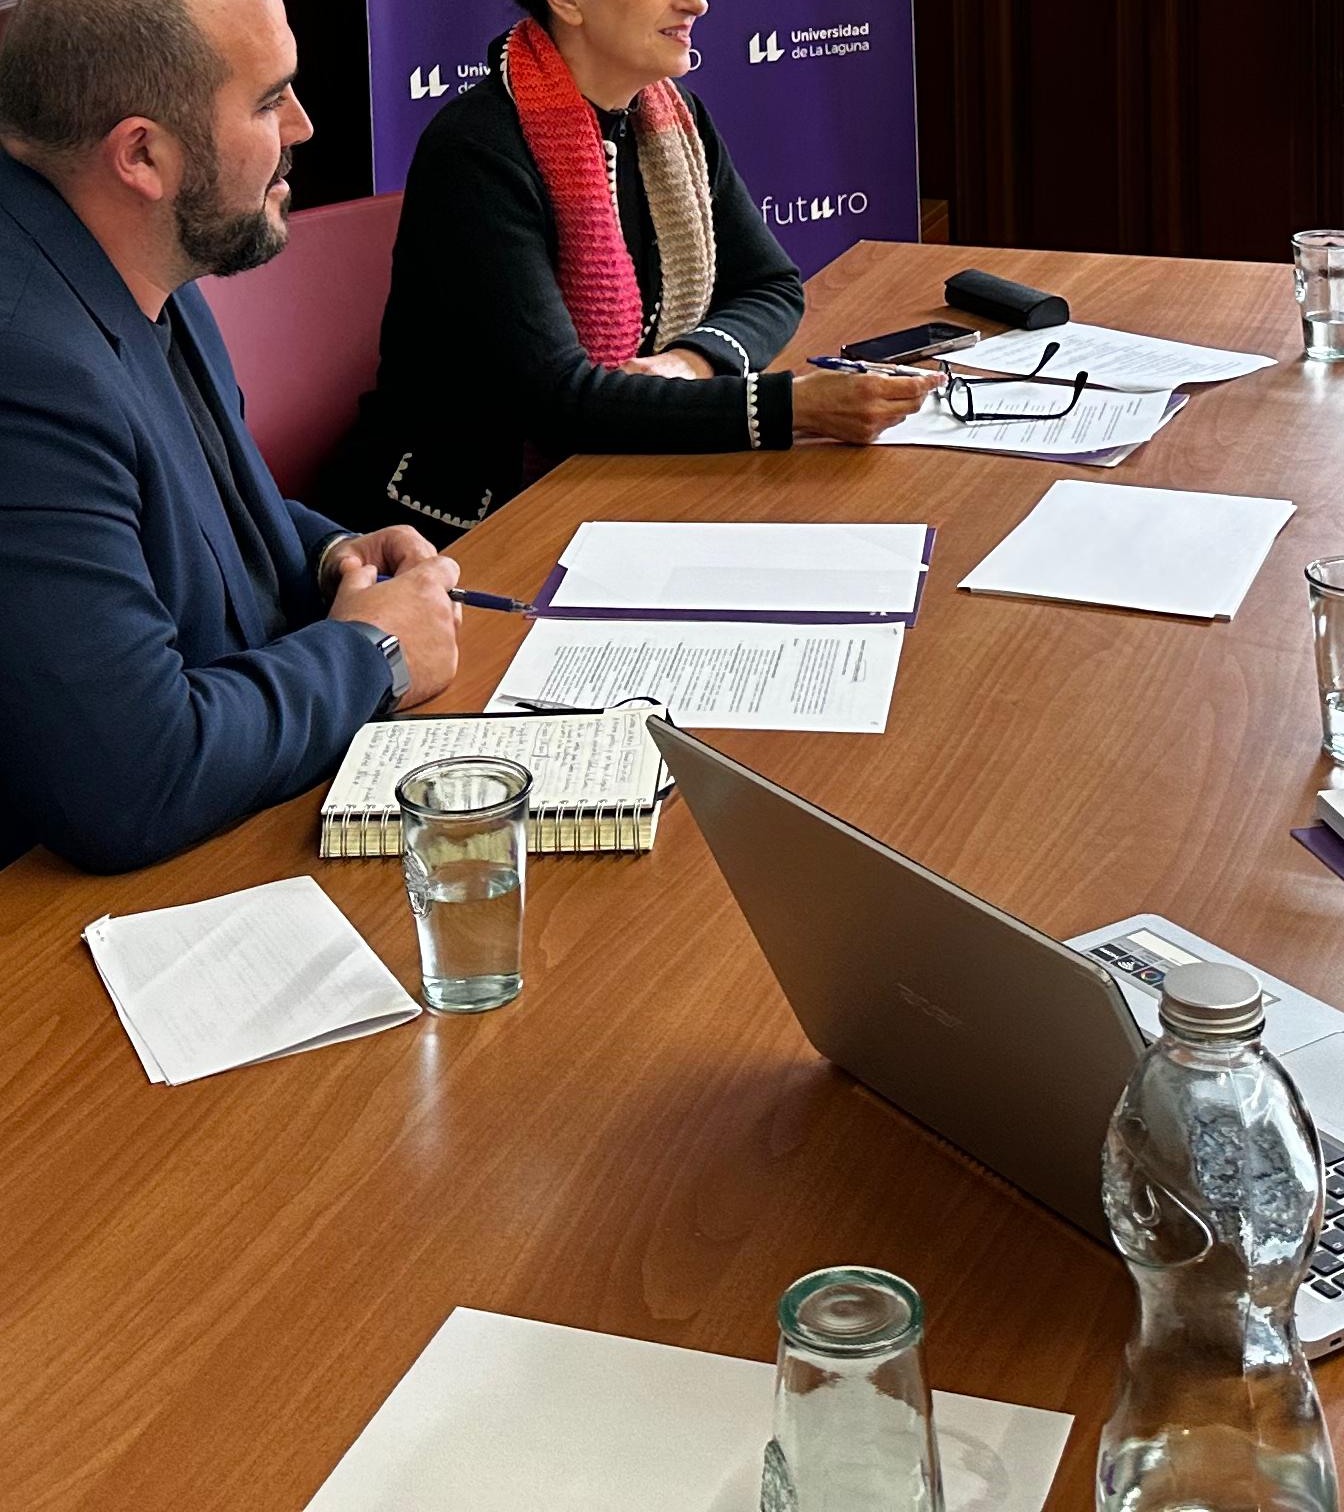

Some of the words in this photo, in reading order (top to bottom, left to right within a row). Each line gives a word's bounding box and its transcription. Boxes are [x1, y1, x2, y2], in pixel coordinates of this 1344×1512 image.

[791, 22, 870, 43] Universidad
[791, 45, 808, 59] de
[809, 43, 823, 57] La
[824, 39, 870, 56] Laguna
[457, 62, 491, 78] Univ
